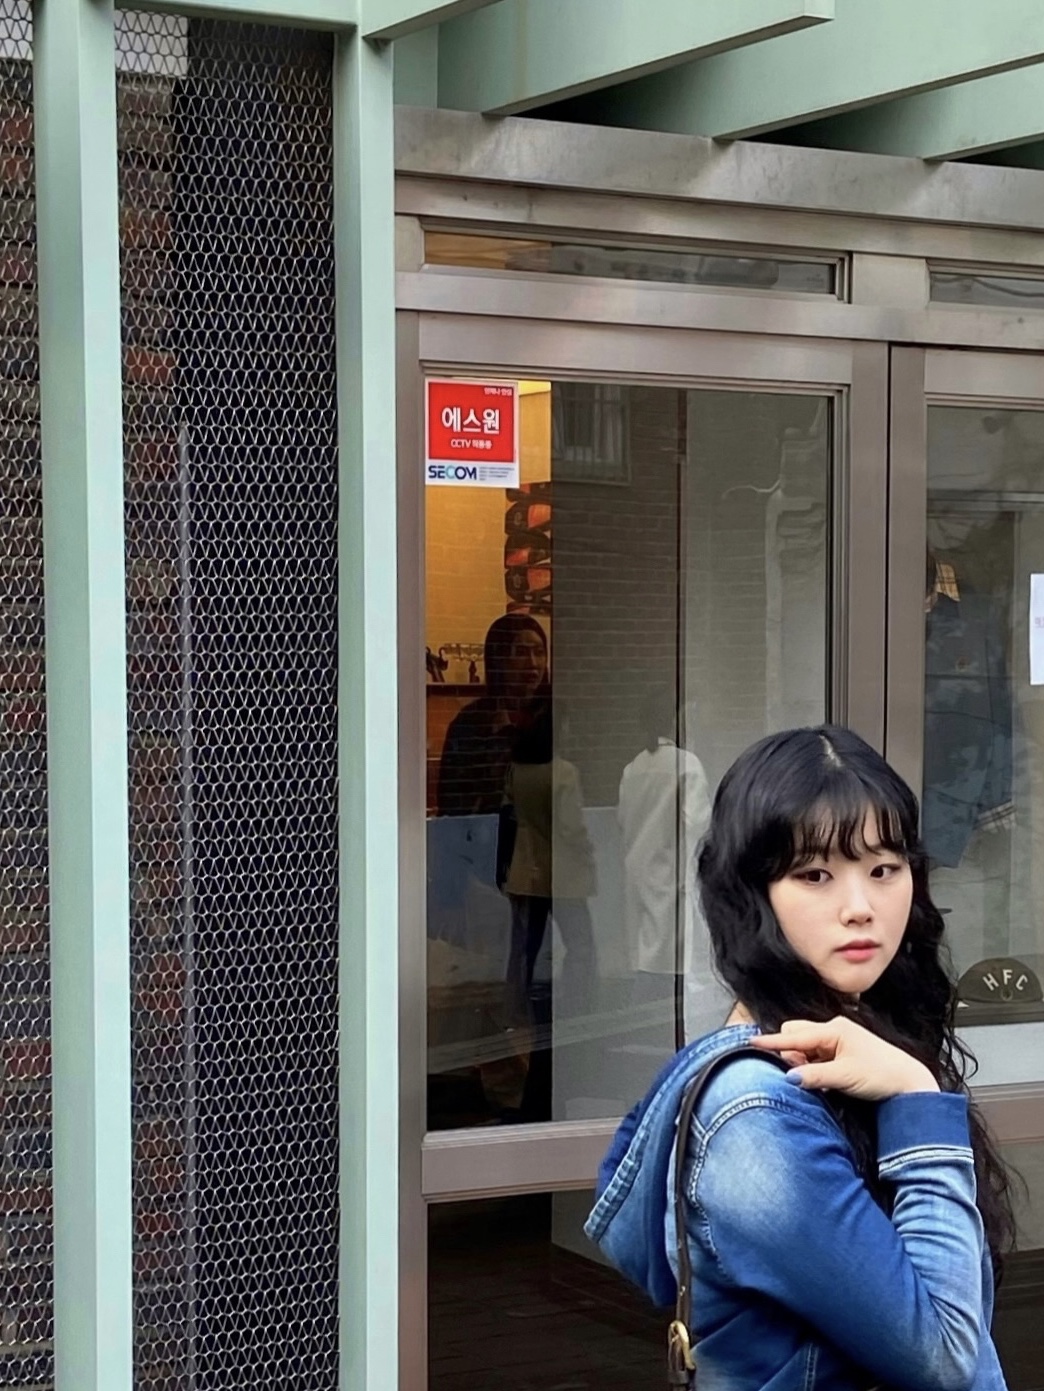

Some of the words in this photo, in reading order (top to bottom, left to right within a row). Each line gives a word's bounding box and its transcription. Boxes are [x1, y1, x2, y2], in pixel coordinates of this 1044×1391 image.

[441, 406, 500, 434] 에스원
[450, 438, 471, 448] CCTV
[428, 465, 477, 480] SECOM
[982, 969, 1029, 992] HFC
